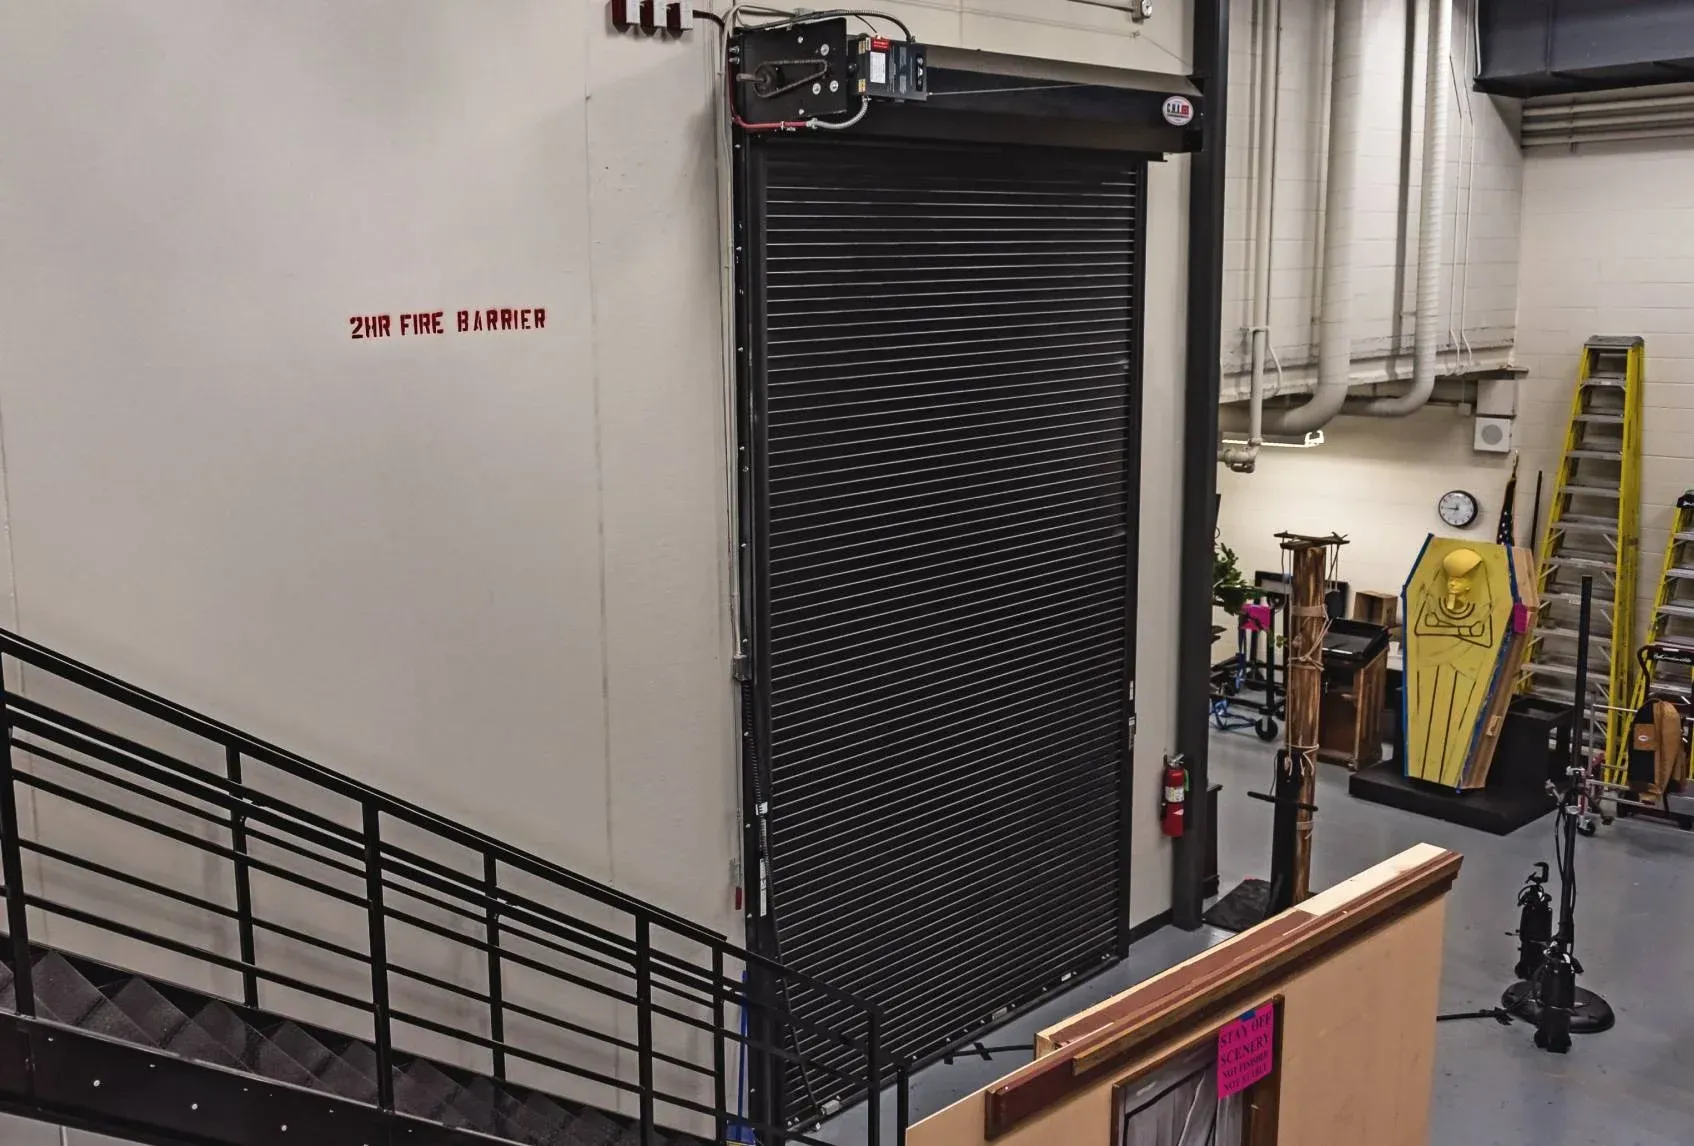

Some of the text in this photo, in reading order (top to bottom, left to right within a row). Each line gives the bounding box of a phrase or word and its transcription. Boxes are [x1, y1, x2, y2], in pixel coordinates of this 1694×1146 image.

[349, 308, 546, 339] 2HR FIRE BARRIER
[1221, 1011, 1271, 1047] STAY OFF
[1221, 1033, 1269, 1064] SCENERY
